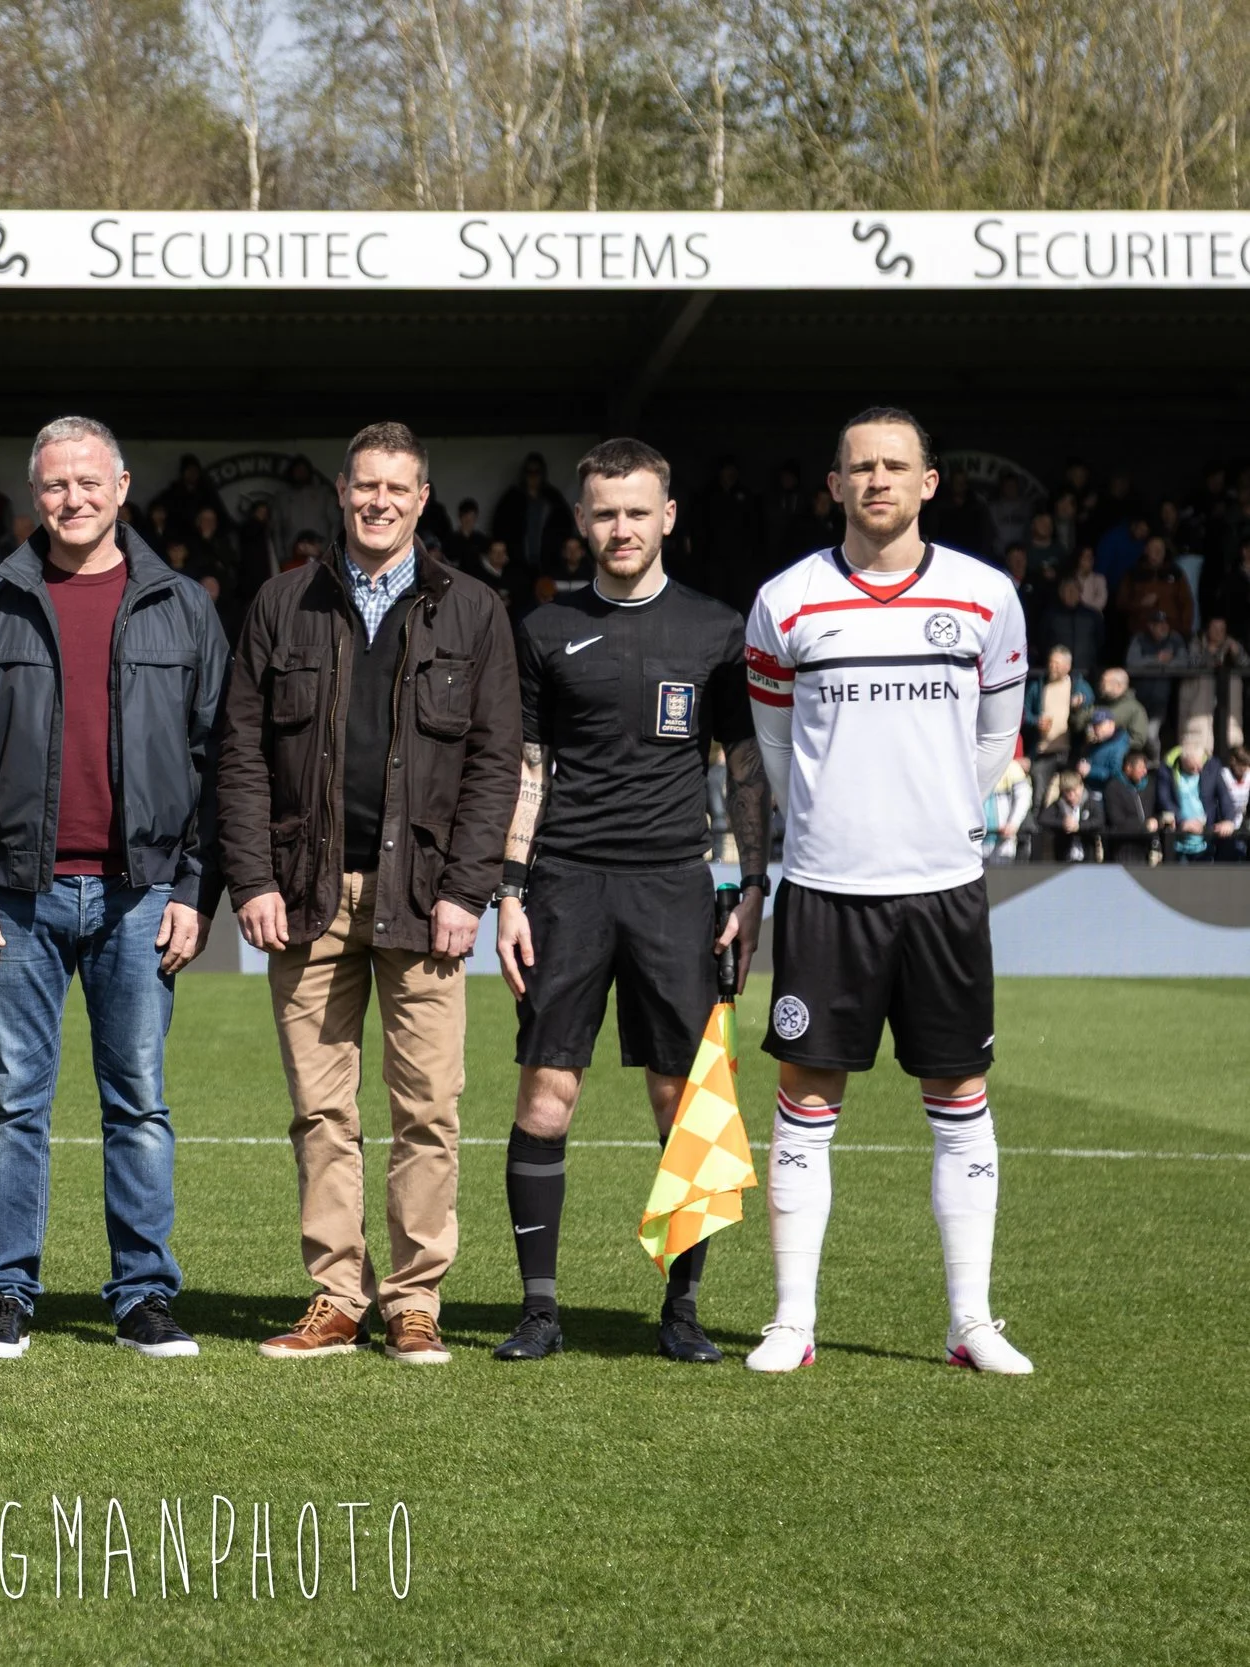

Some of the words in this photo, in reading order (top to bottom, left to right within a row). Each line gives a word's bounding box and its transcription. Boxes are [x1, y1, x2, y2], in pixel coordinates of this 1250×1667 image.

[89, 219, 389, 279] SECURITEC
[458, 221, 710, 279] SYSTEMS
[748, 669, 781, 690] CAPTAIN
[818, 683, 859, 704] THE
[870, 681, 960, 702] PITMEN
